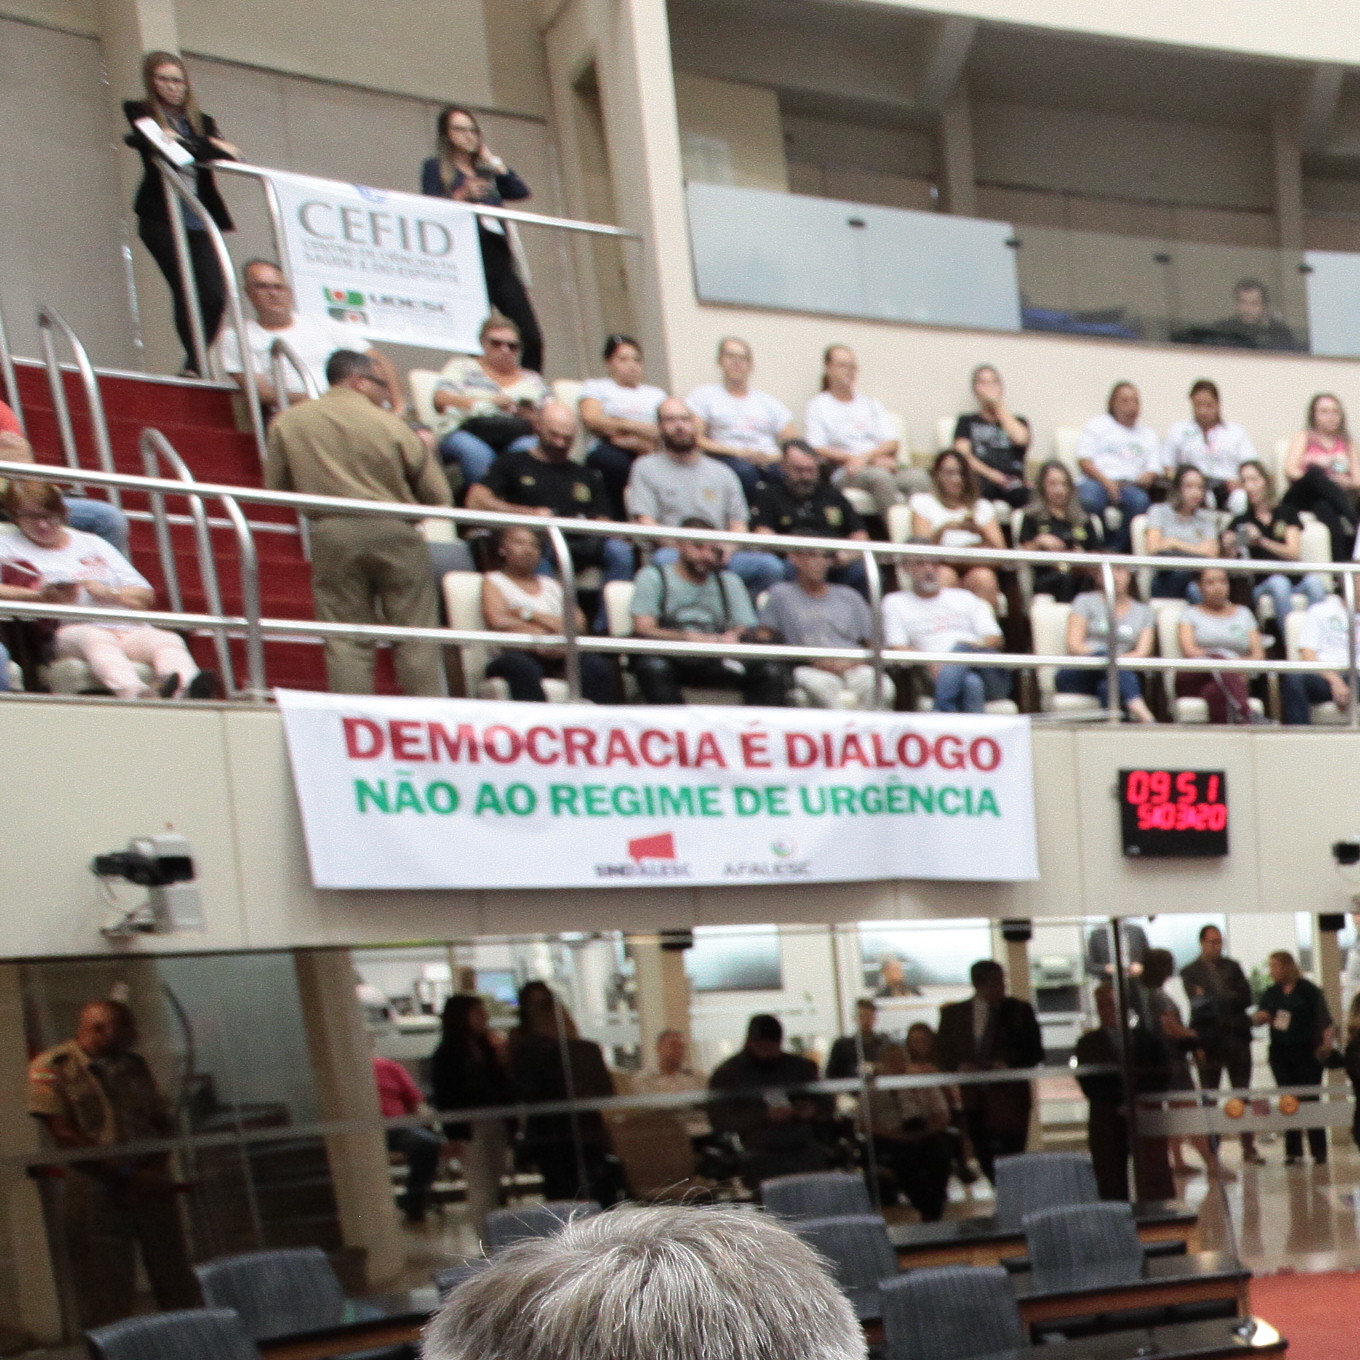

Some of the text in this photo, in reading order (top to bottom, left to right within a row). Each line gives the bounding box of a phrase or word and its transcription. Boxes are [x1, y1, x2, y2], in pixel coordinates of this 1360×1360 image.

[298, 202, 453, 257] CEFID
[342, 717, 1003, 772] DEMOCRACIA É DIÁLOGO
[354, 769, 1002, 818] NÃO AO REGIME DE URGÊNCIA
